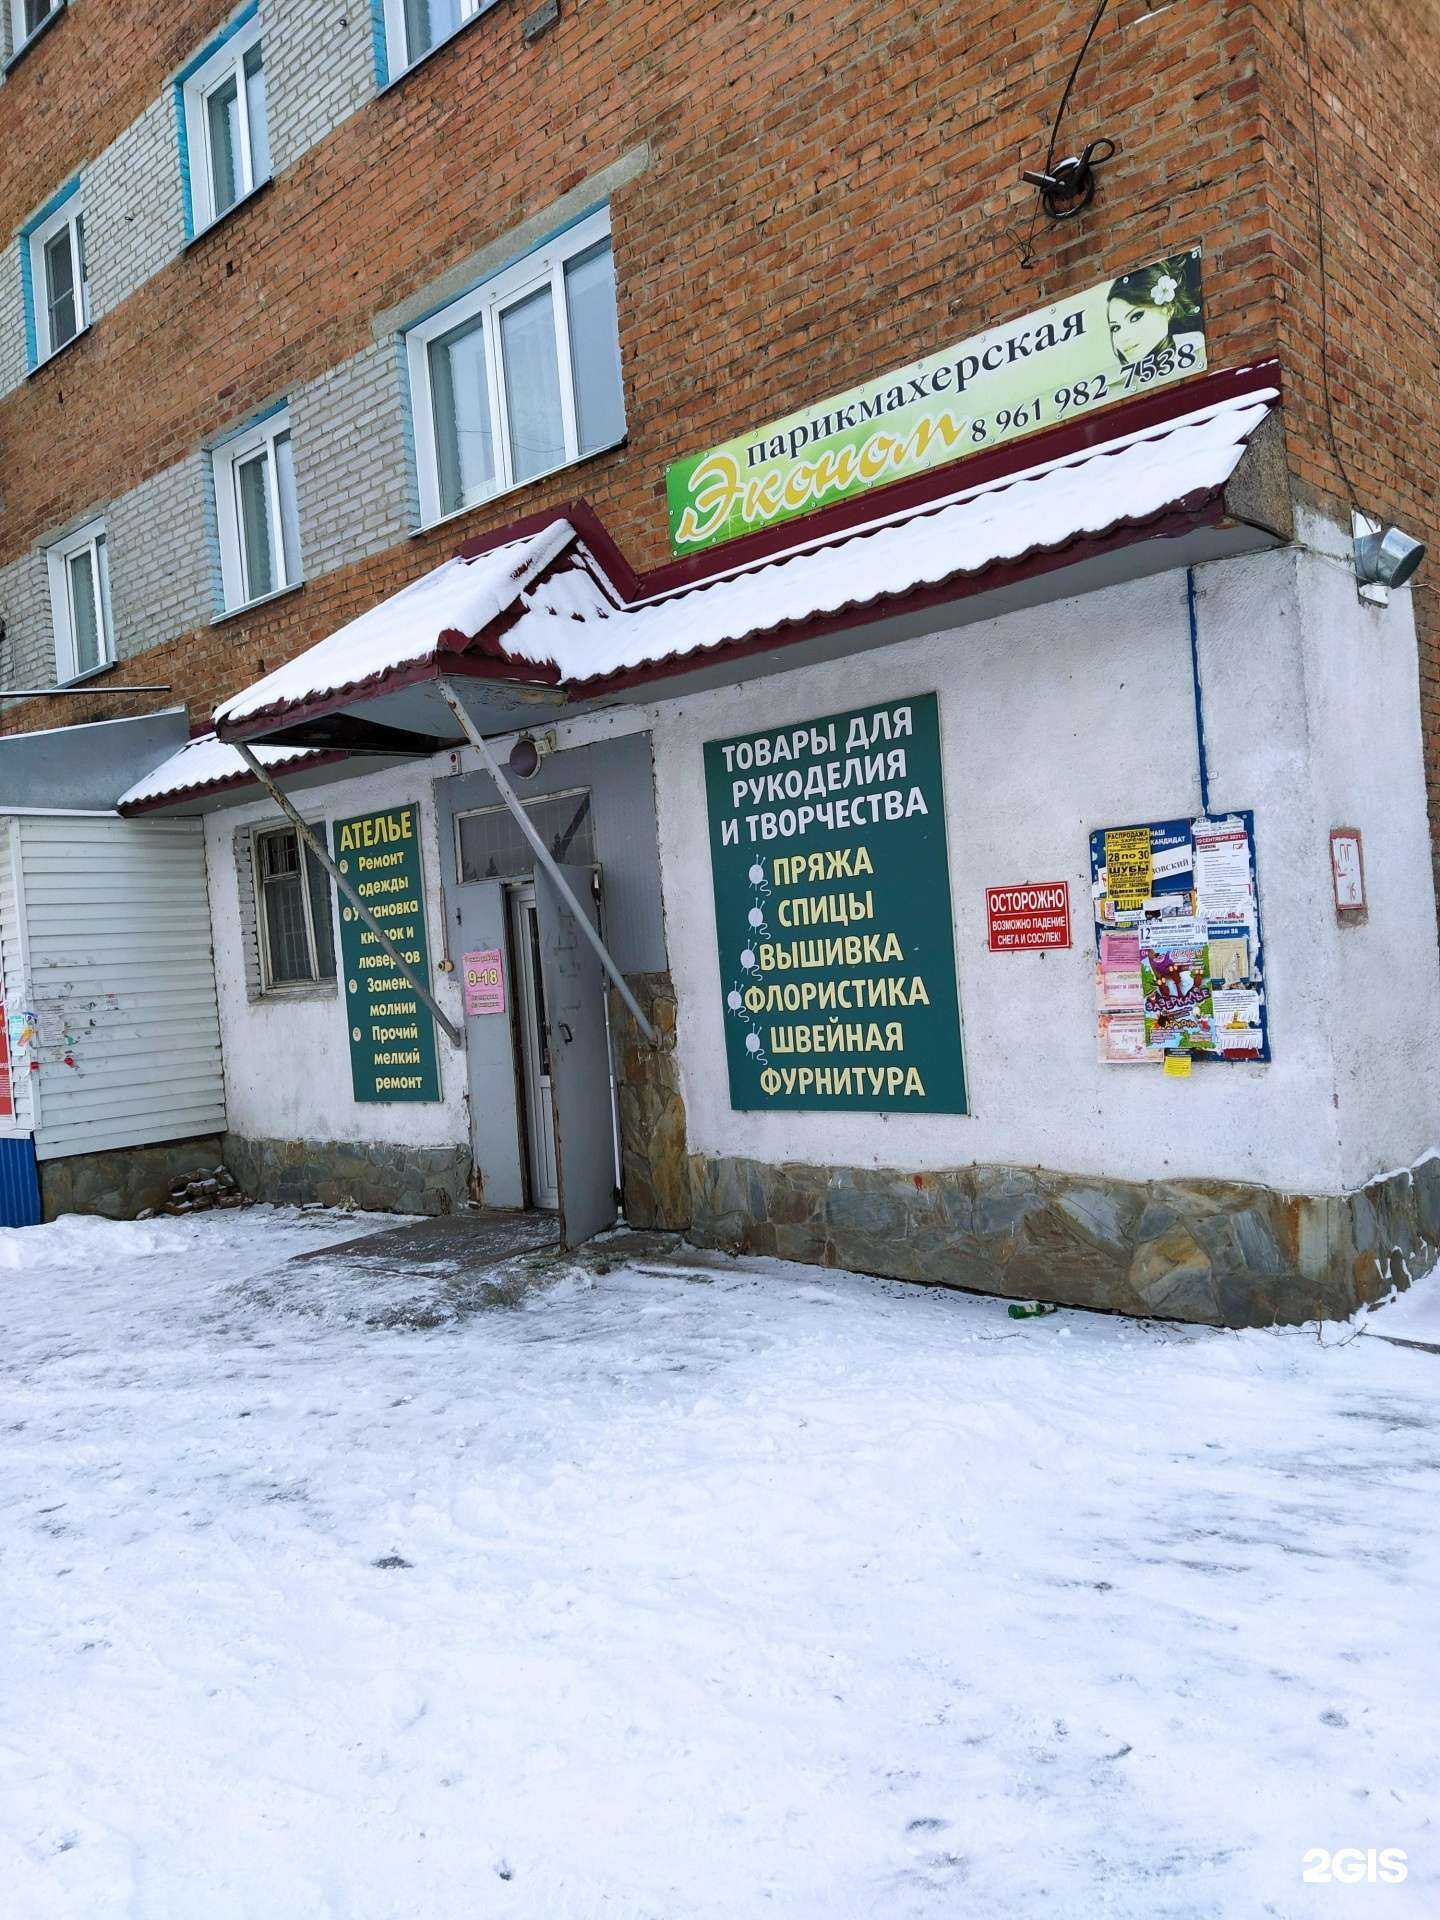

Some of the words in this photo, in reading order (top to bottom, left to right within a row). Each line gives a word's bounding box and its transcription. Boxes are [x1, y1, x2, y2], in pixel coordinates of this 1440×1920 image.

[745, 306, 1087, 468] парикмахерская
[970, 420, 988, 443] 8
[995, 399, 1043, 434] 961
[1054, 374, 1109, 416] 982
[1120, 342, 1197, 389] 7538
[722, 724, 836, 772] ТОВАРЫ
[846, 706, 913, 753] ДЛЯ
[732, 749, 907, 808] РУКОДЕЛИЯ
[721, 819, 739, 846] И
[746, 787, 928, 842] ТВОРЧЕСТВА
[340, 811, 412, 851] АТЕЛЬЕ
[358, 851, 405, 871] Ремонт
[773, 847, 874, 886] ПРЯЖА
[1108, 853, 1120, 862] 28
[1109, 865, 1149, 874] ШУБЫ
[358, 876, 409, 898] одежды
[990, 888, 1065, 912] ОСТОРОЖНО
[778, 890, 874, 927] СПИЦЫ
[992, 918, 1032, 931] ВОЗМОЖНО
[1032, 916, 1066, 930] ПАДЕНИЕ
[759, 933, 904, 971] ВЫШИВКА
[997, 934, 1020, 945] СНЕГА
[1020, 934, 1026, 943] И
[468, 968, 499, 987] 9-18
[744, 976, 930, 1013] ФЛОРИСТИКА
[370, 1002, 416, 1017] молнии
[372, 1023, 418, 1044] Прочий
[770, 1016, 904, 1053] ШВЕЙНАЯ
[374, 1048, 420, 1065] мелкий
[375, 1076, 423, 1093] ремонт
[760, 1067, 925, 1096] ФУРНИТУРА
